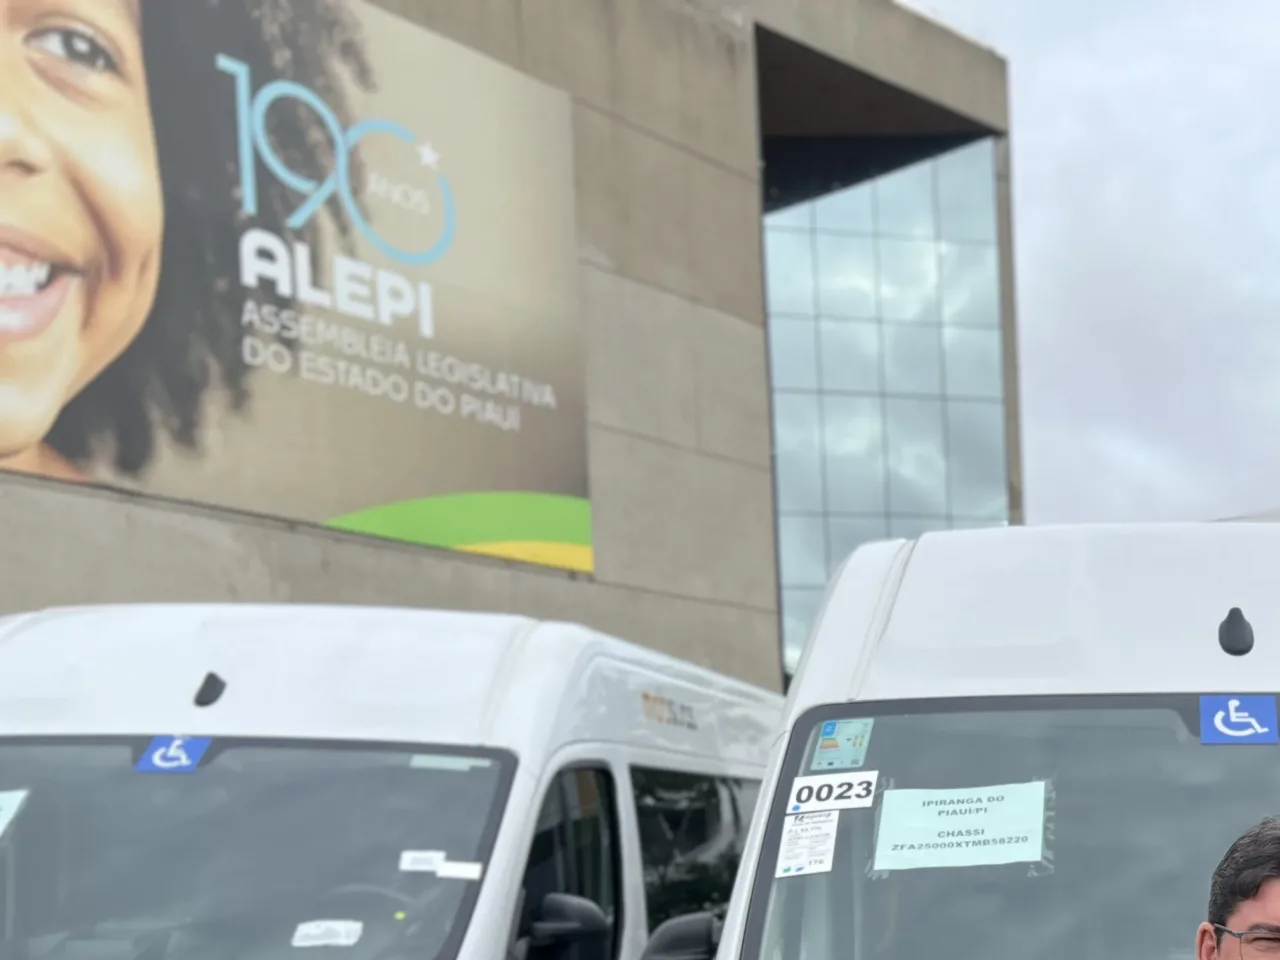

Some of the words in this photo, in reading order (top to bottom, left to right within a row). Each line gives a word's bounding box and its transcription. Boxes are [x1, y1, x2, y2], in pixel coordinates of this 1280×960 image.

[216, 53, 455, 265] 190
[239, 228, 434, 339] ALEPI
[241, 299, 410, 369] ASSEMBLEIA
[416, 351, 558, 409] LEGISLATIVA
[242, 335, 292, 373] DO
[301, 352, 408, 403] ESTADO
[414, 381, 456, 415] DO
[796, 780, 873, 804] 0023
[922, 796, 983, 807] IPIRANGA
[987, 795, 1005, 803] DO
[937, 829, 985, 838] CHASSI
